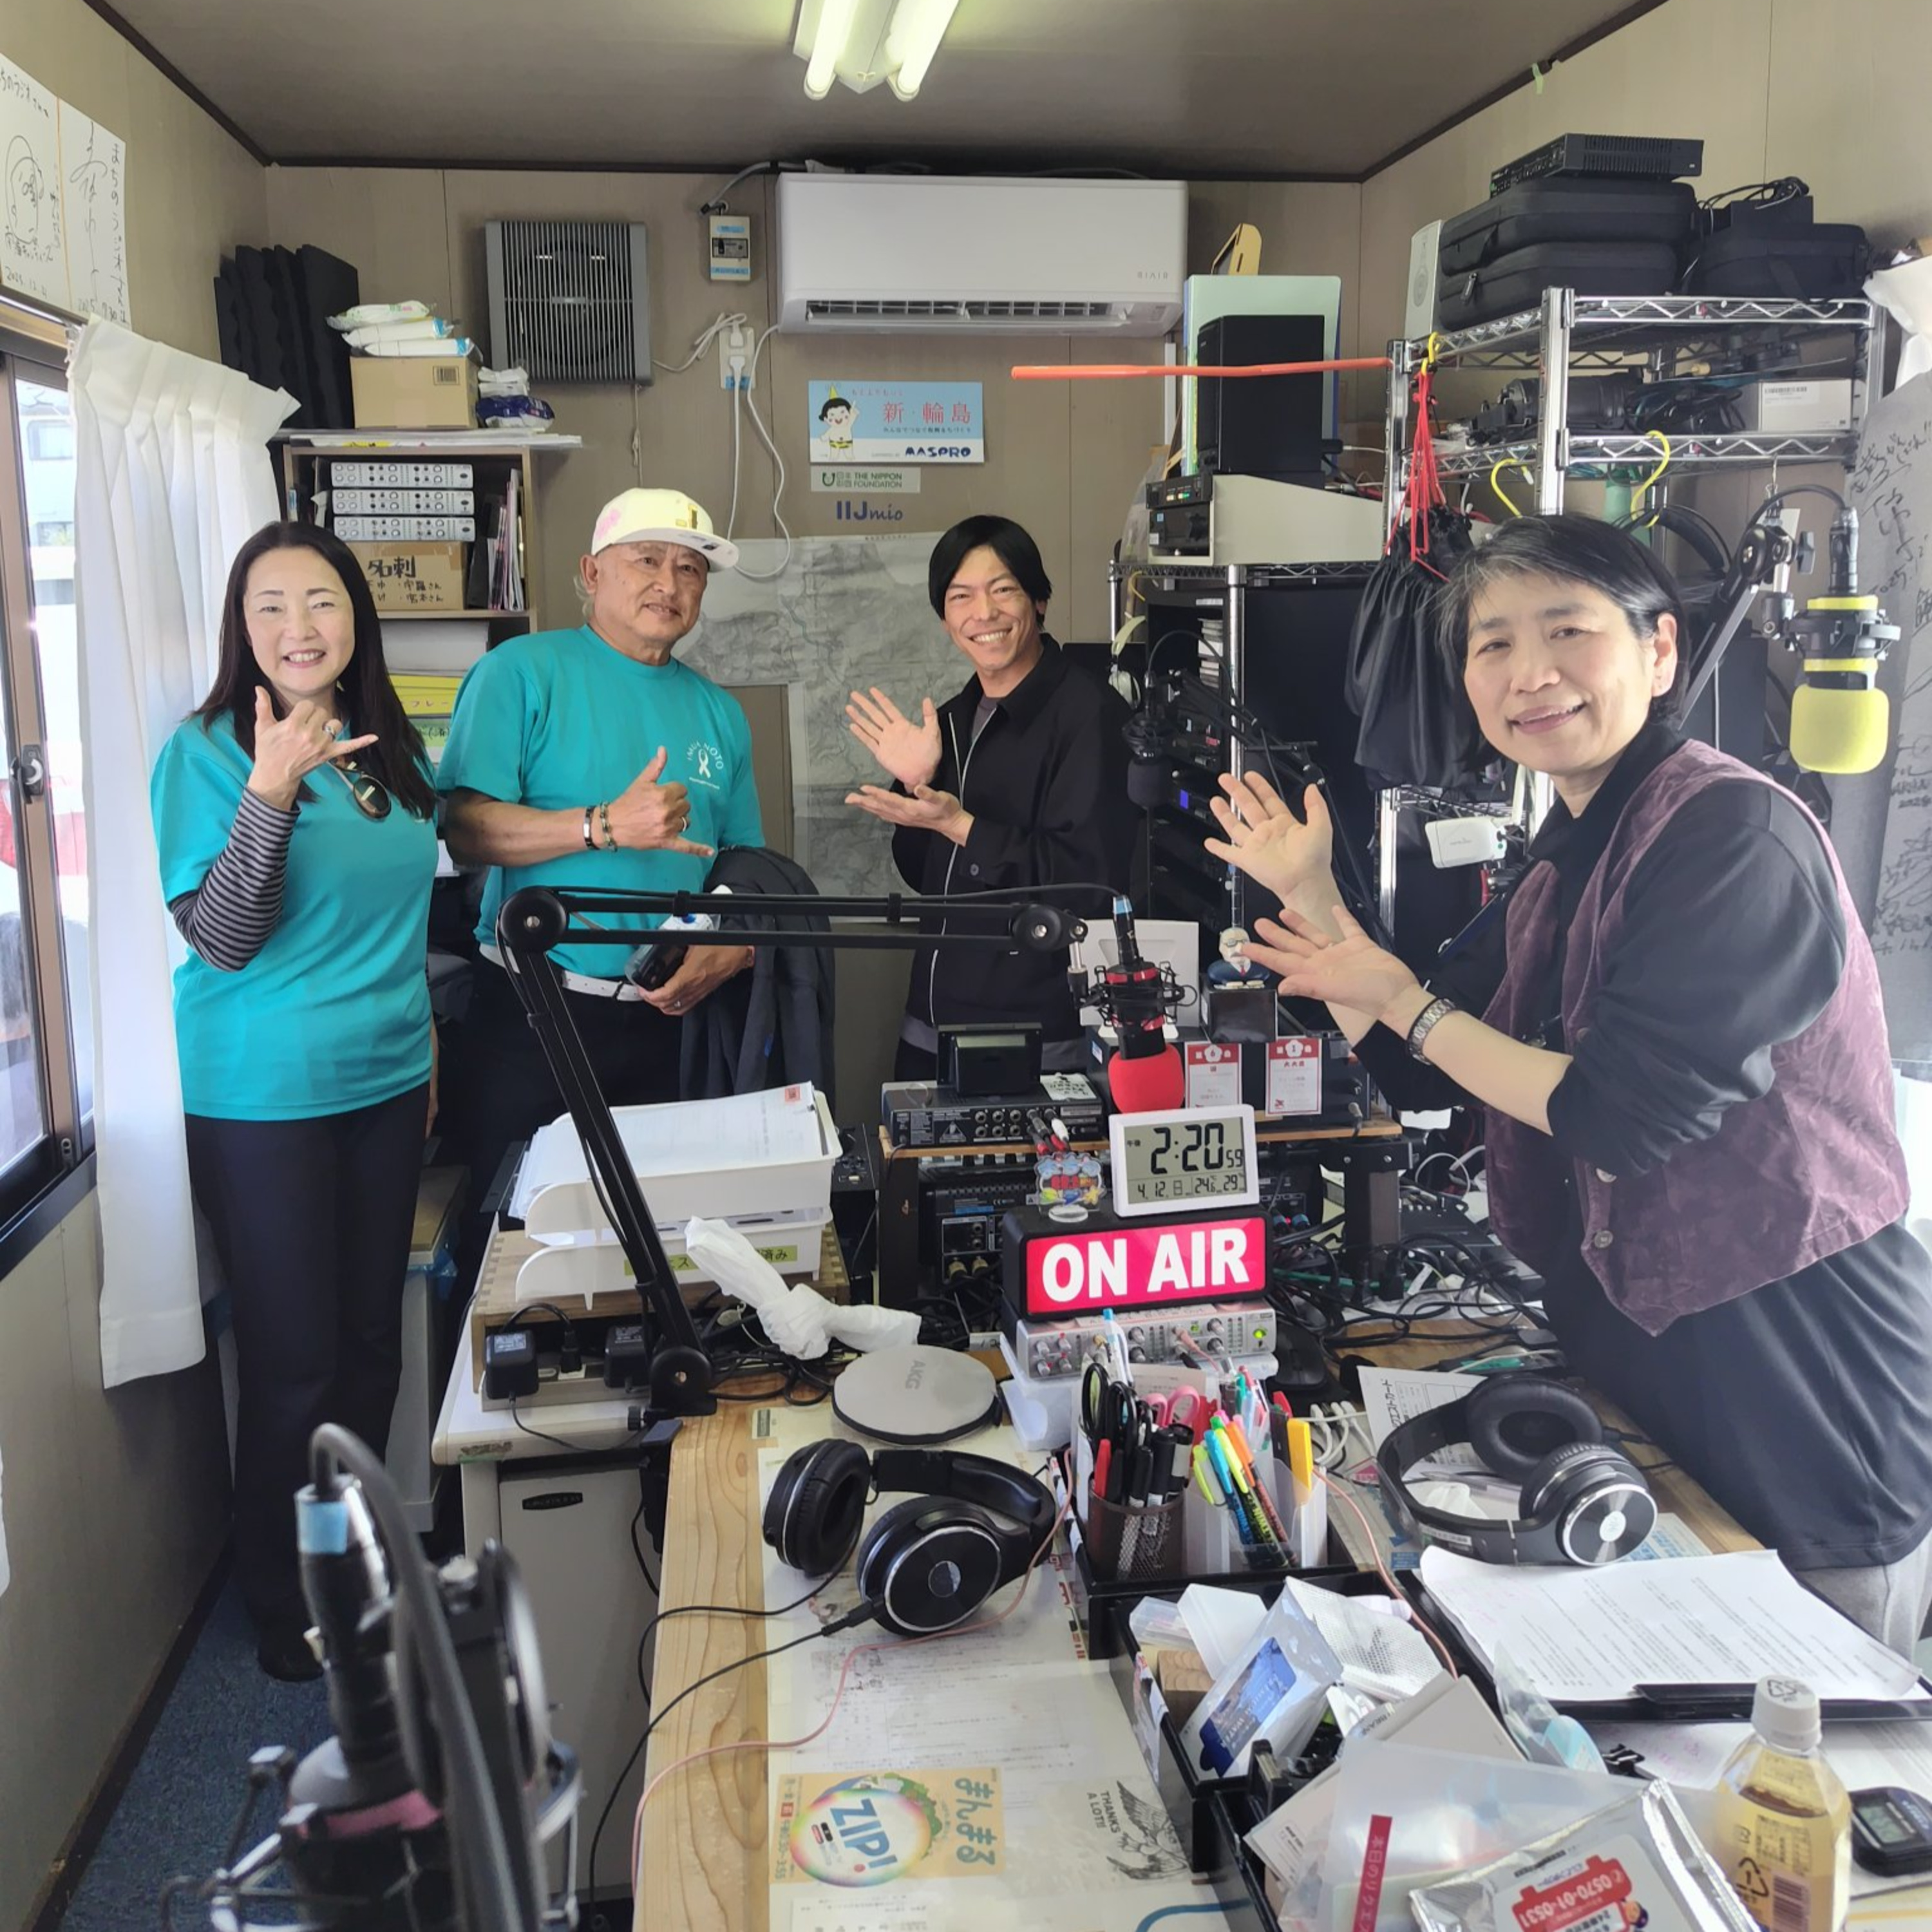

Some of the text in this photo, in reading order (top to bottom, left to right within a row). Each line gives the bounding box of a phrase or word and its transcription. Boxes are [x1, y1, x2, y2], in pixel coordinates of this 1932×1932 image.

[905, 446, 972, 458] MASPRO
[853, 480, 902, 488] FOUNDATION
[871, 472, 902, 480] NIPPON
[836, 500, 904, 521] IIJmio
[368, 555, 416, 578] 名刺
[1150, 1122, 1224, 1175] 2:20
[1226, 1148, 1244, 1168] 59
[1173, 1180, 1183, 1196] 日
[1224, 1174, 1238, 1191] 29
[1042, 1228, 1249, 1303] ON AIR
[905, 1359, 926, 1390] AKG
[954, 1777, 998, 1866] まんまる
[1100, 1790, 1121, 1833] THANKS
[829, 1797, 898, 1873] ZIP!
